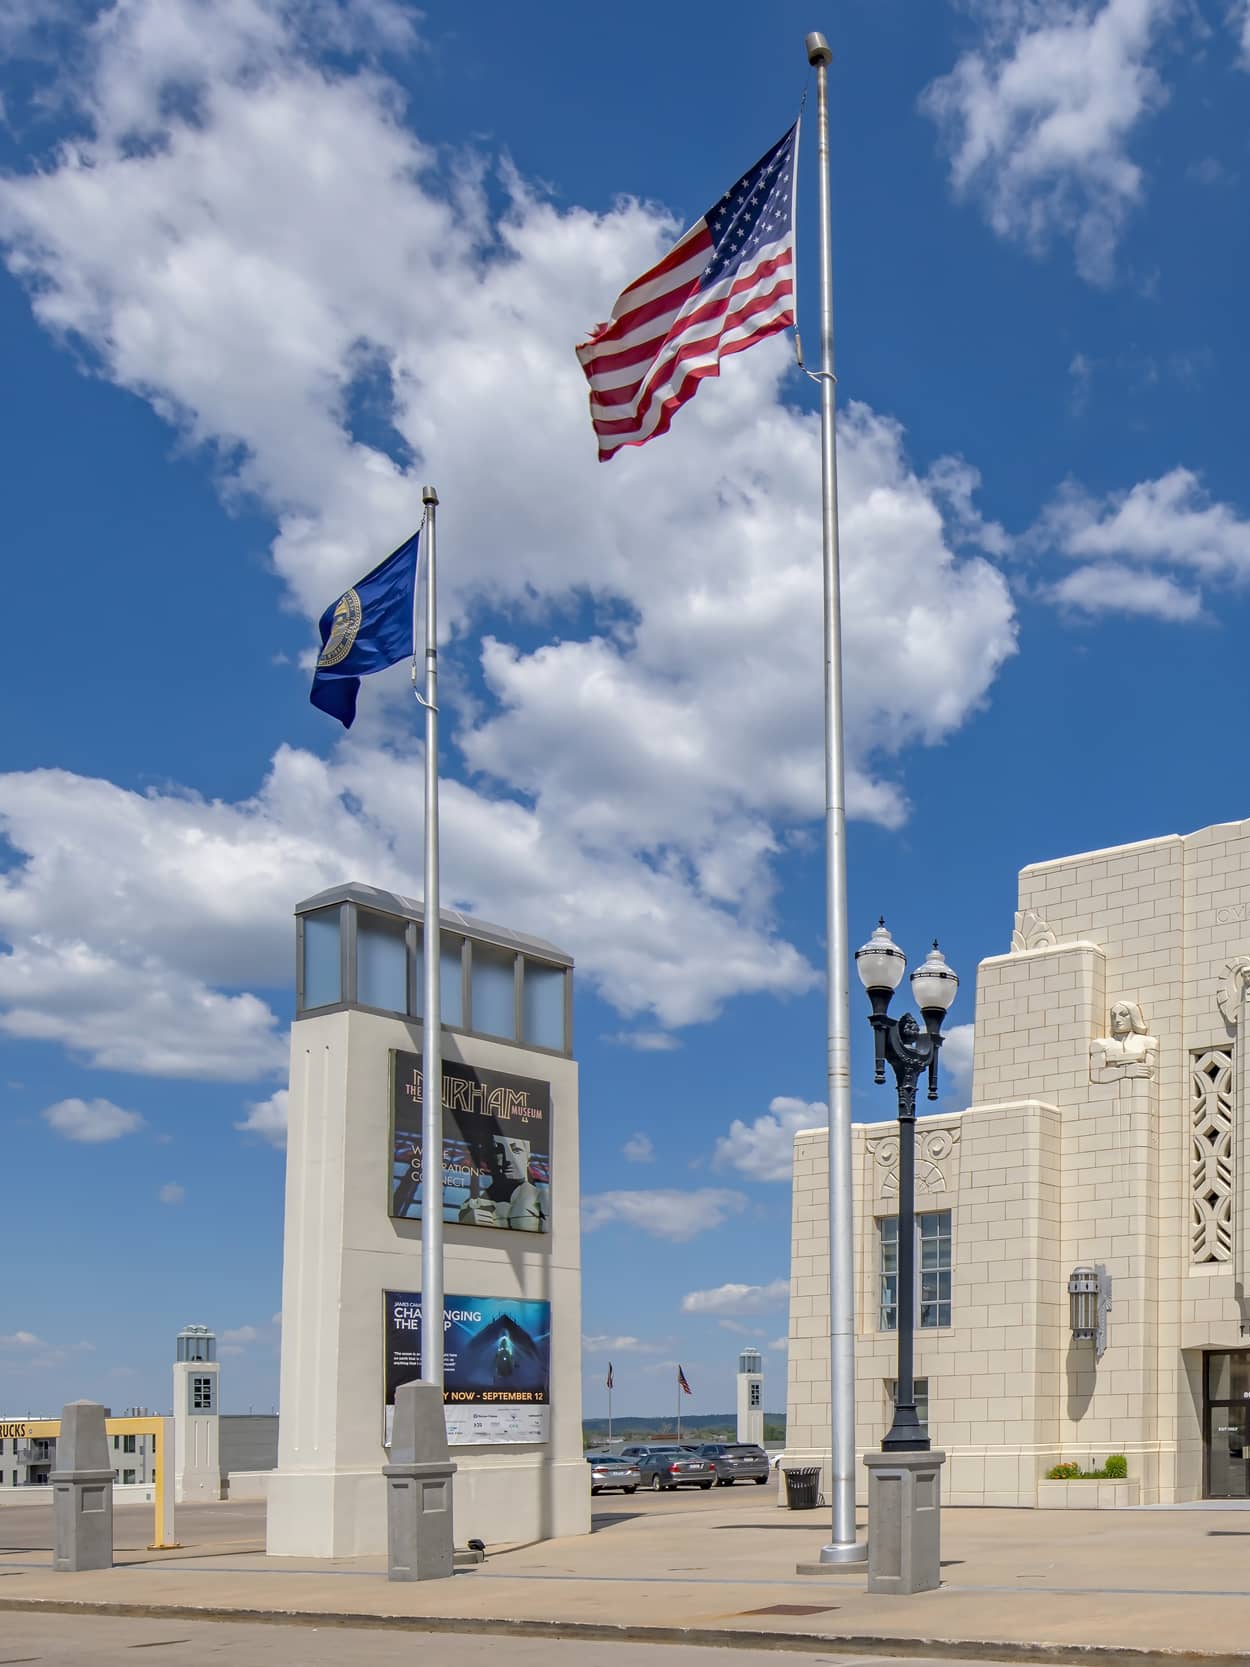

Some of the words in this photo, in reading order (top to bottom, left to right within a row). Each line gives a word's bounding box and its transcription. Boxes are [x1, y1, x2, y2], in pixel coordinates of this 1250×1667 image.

[406, 1084, 422, 1096] THE
[511, 1105, 543, 1120] MUSEUM
[411, 1158, 485, 1177] GATIONS
[411, 1171, 465, 1187] CECT
[394, 1308, 482, 1322] CHANGING
[394, 1318, 418, 1330] THE
[451, 1392, 475, 1400] NOW
[482, 1392, 532, 1400] SEPTEMBER
[534, 1392, 543, 1400] 12
